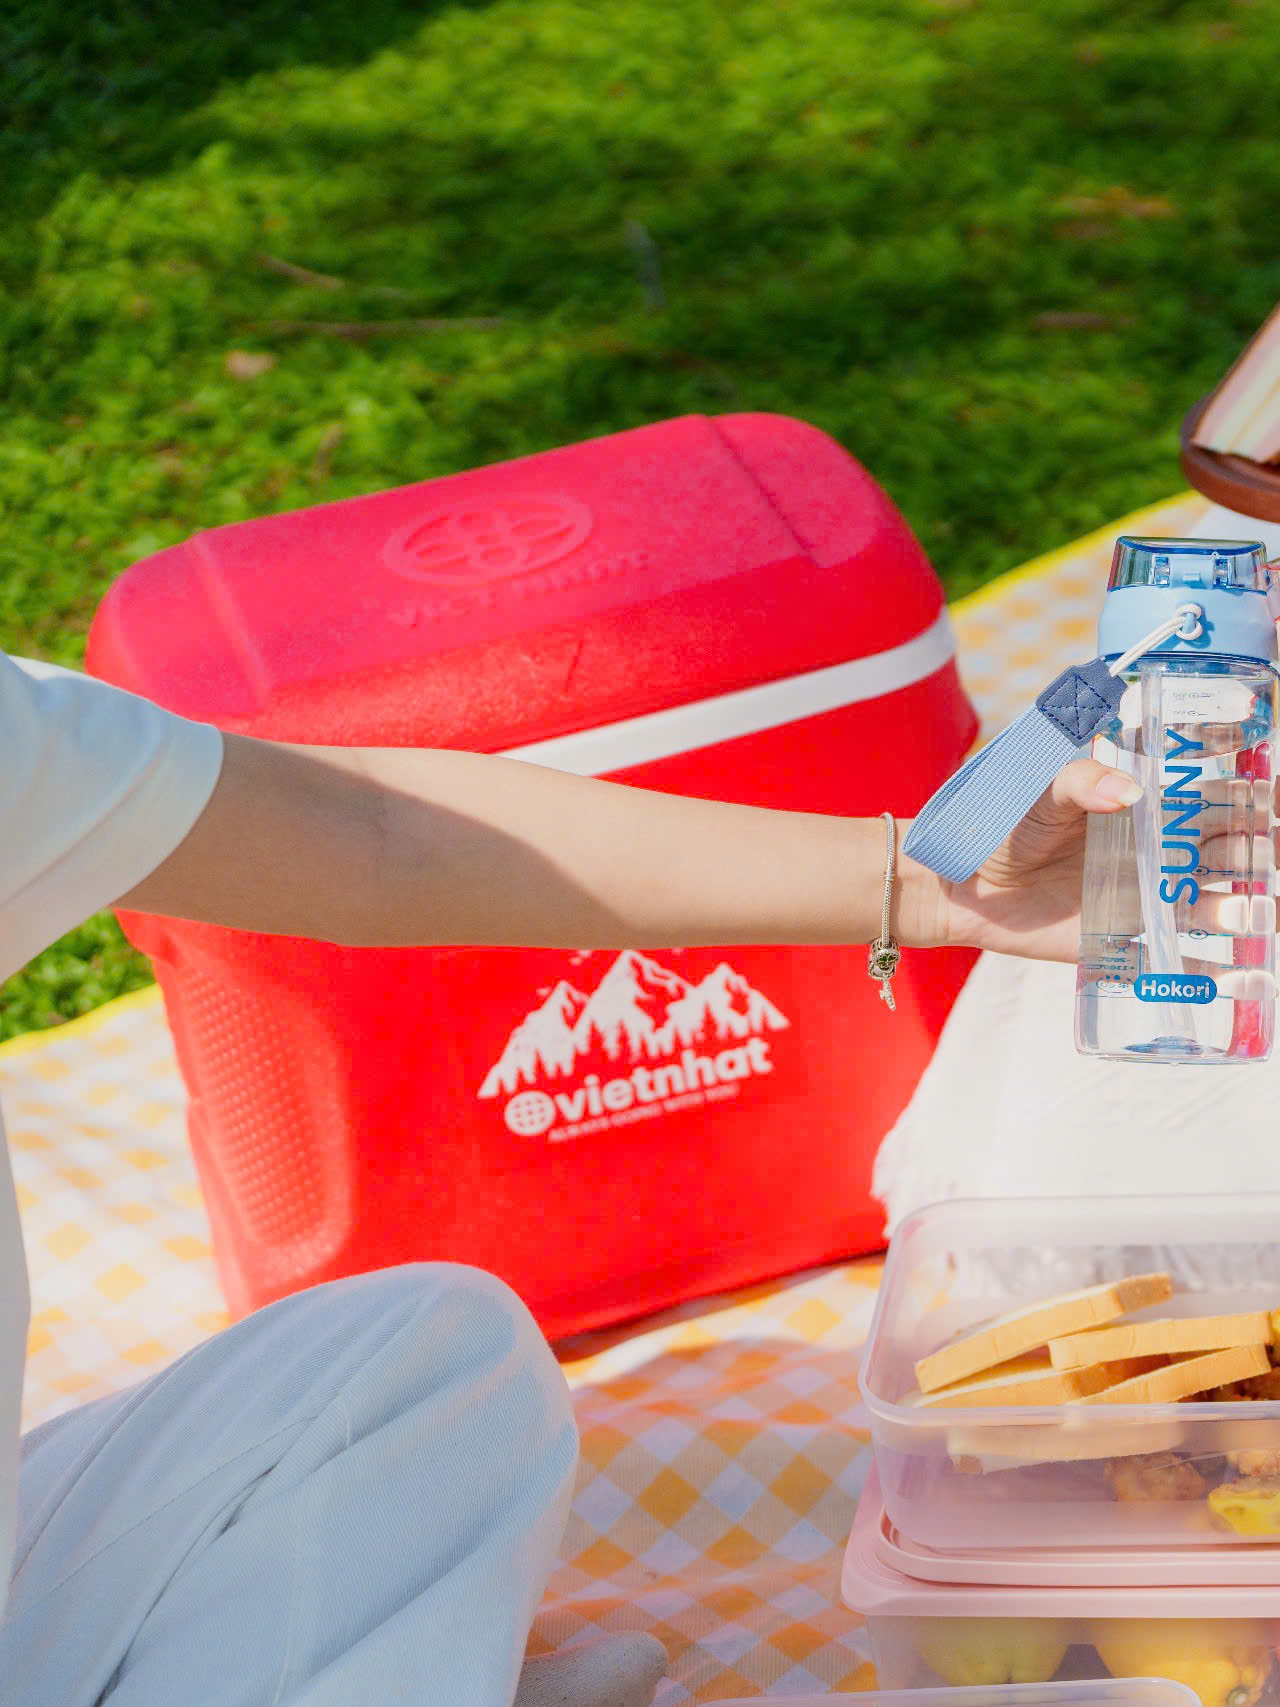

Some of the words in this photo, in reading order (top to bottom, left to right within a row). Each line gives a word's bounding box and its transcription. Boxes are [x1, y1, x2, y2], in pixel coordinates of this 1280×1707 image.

[1159, 728, 1204, 906] SUNNY
[1140, 979, 1210, 999] Hokori
[554, 1037, 773, 1122] vietnhat
